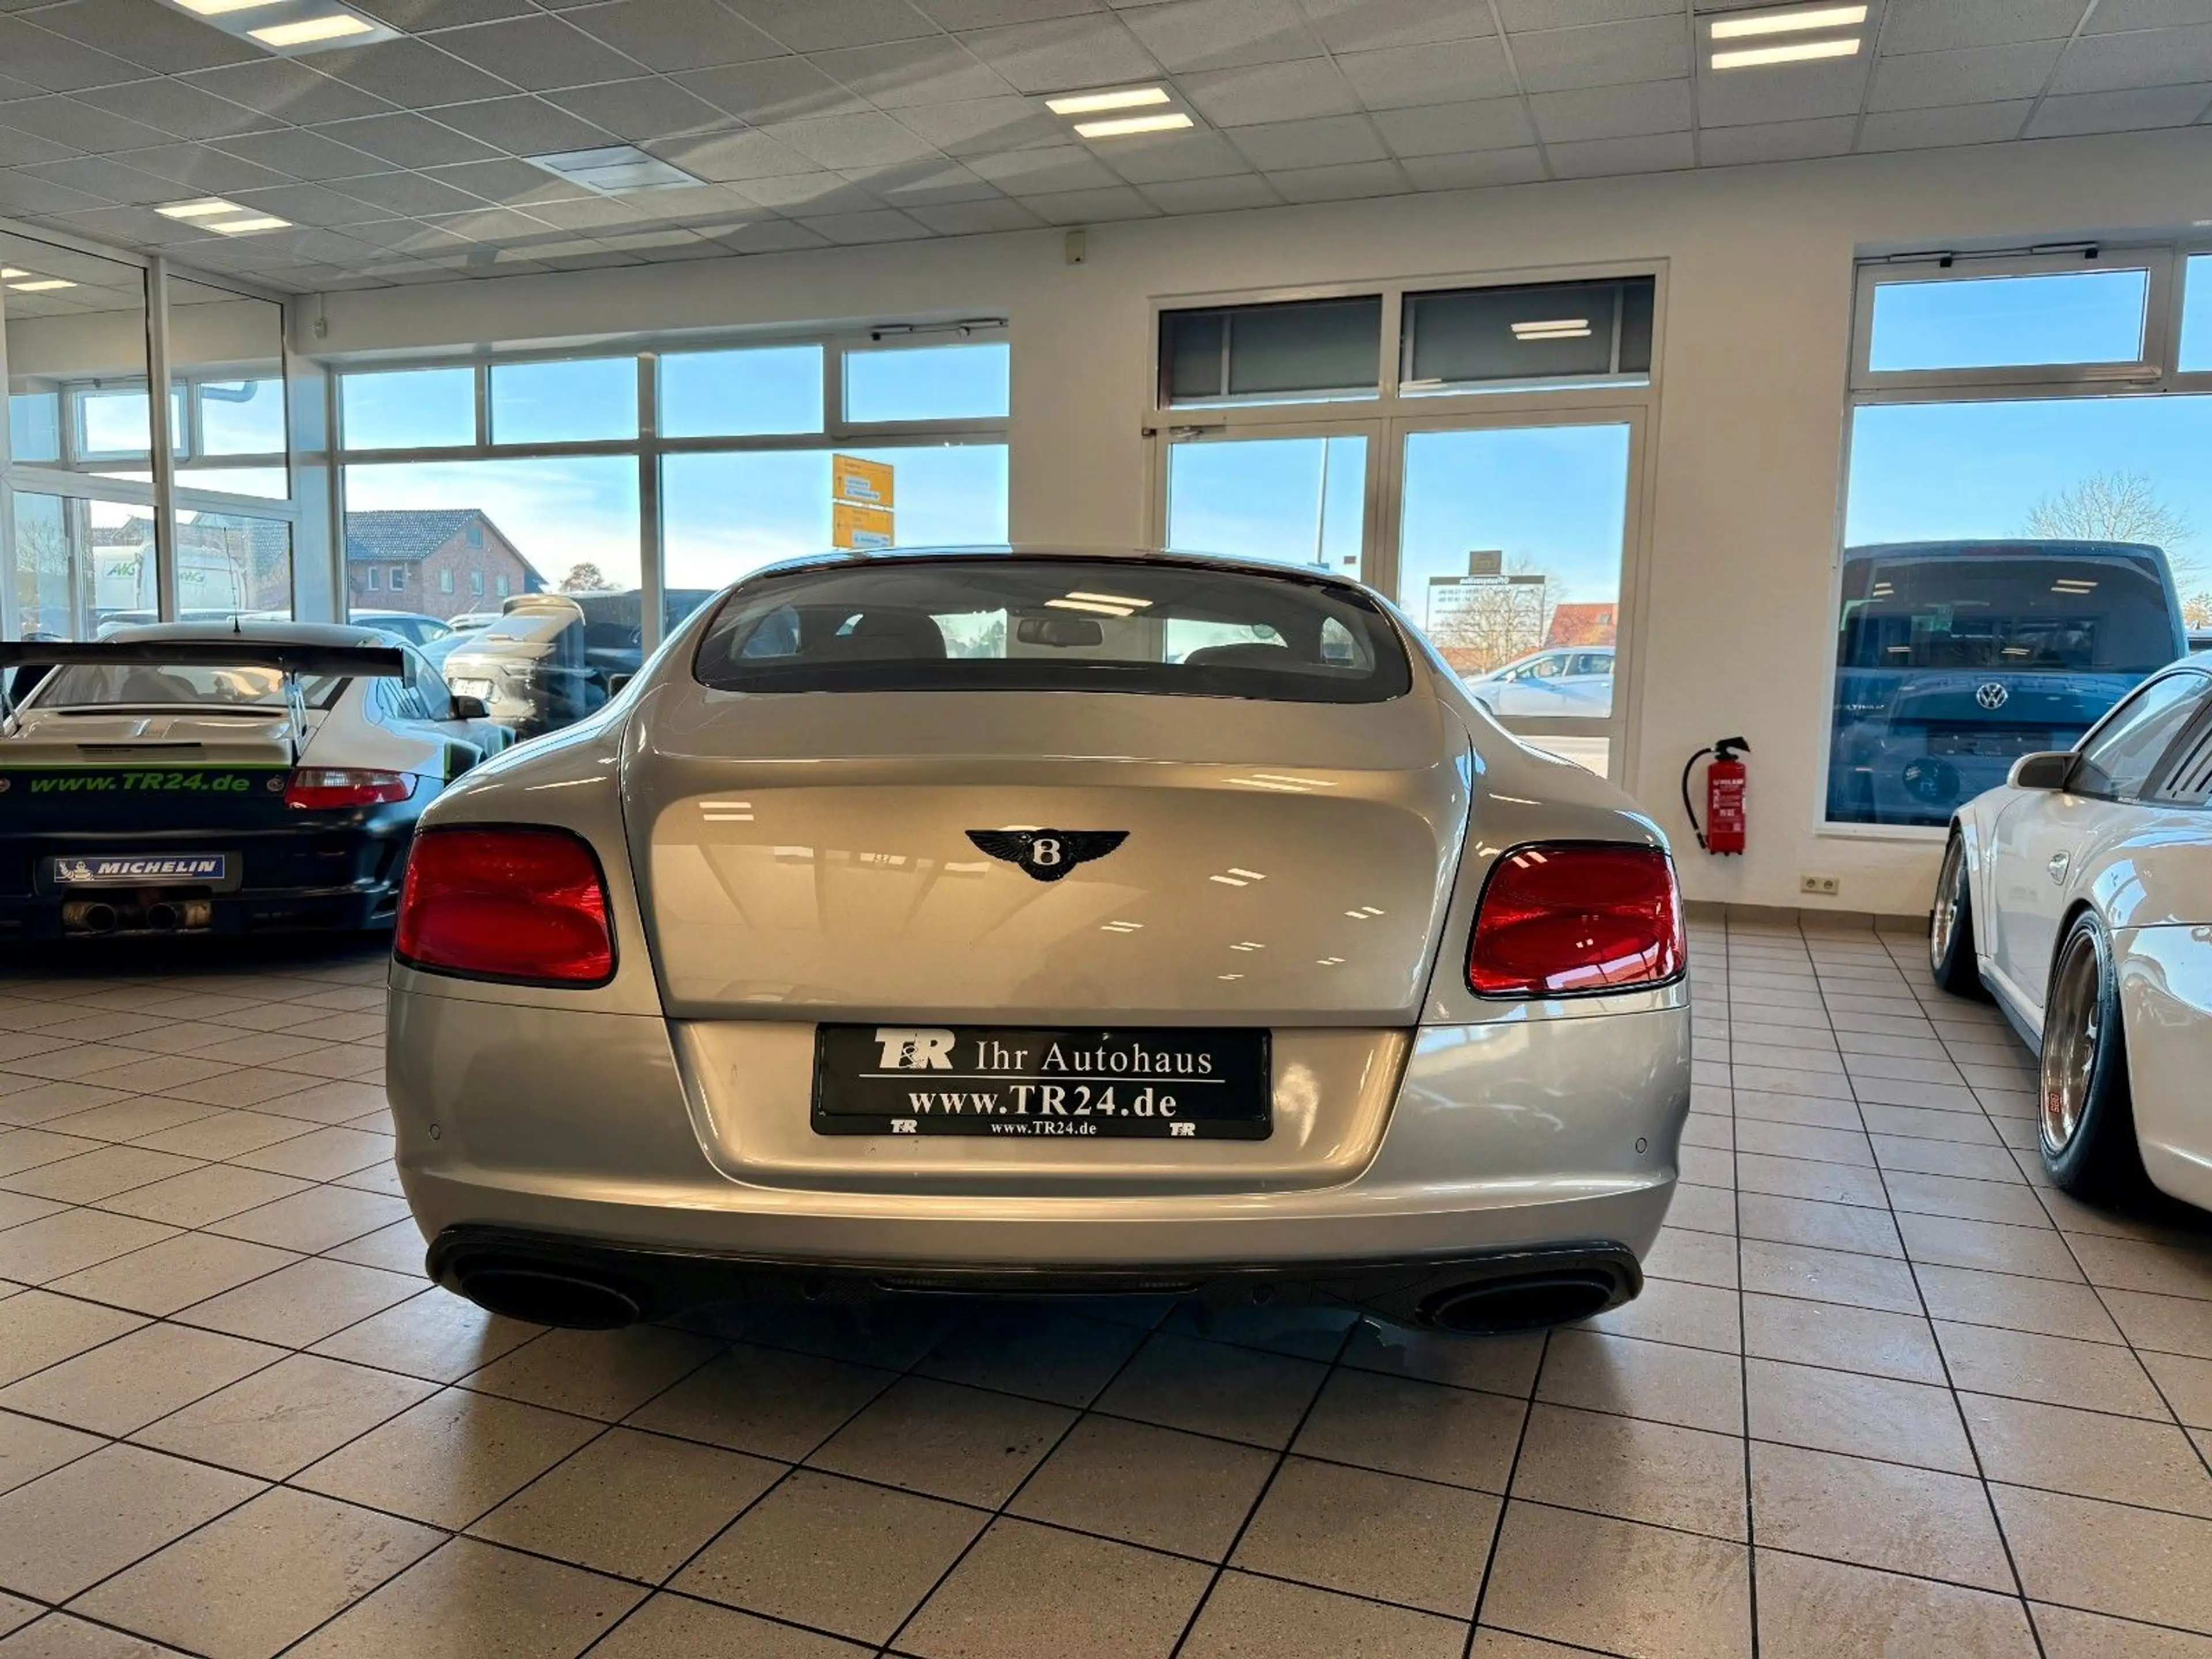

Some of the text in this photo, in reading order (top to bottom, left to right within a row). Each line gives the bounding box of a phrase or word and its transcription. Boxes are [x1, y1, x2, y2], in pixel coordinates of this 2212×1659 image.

[31, 772, 250, 792] www.TR24.de
[1032, 838, 1061, 865] B
[97, 861, 217, 874] MICHELIN
[976, 1041, 1028, 1069] Ihr
[1041, 1039, 1211, 1073] Autohaus
[909, 1085, 1176, 1116] www.TR24.de
[991, 1122, 1096, 1134] www.TR24.de
